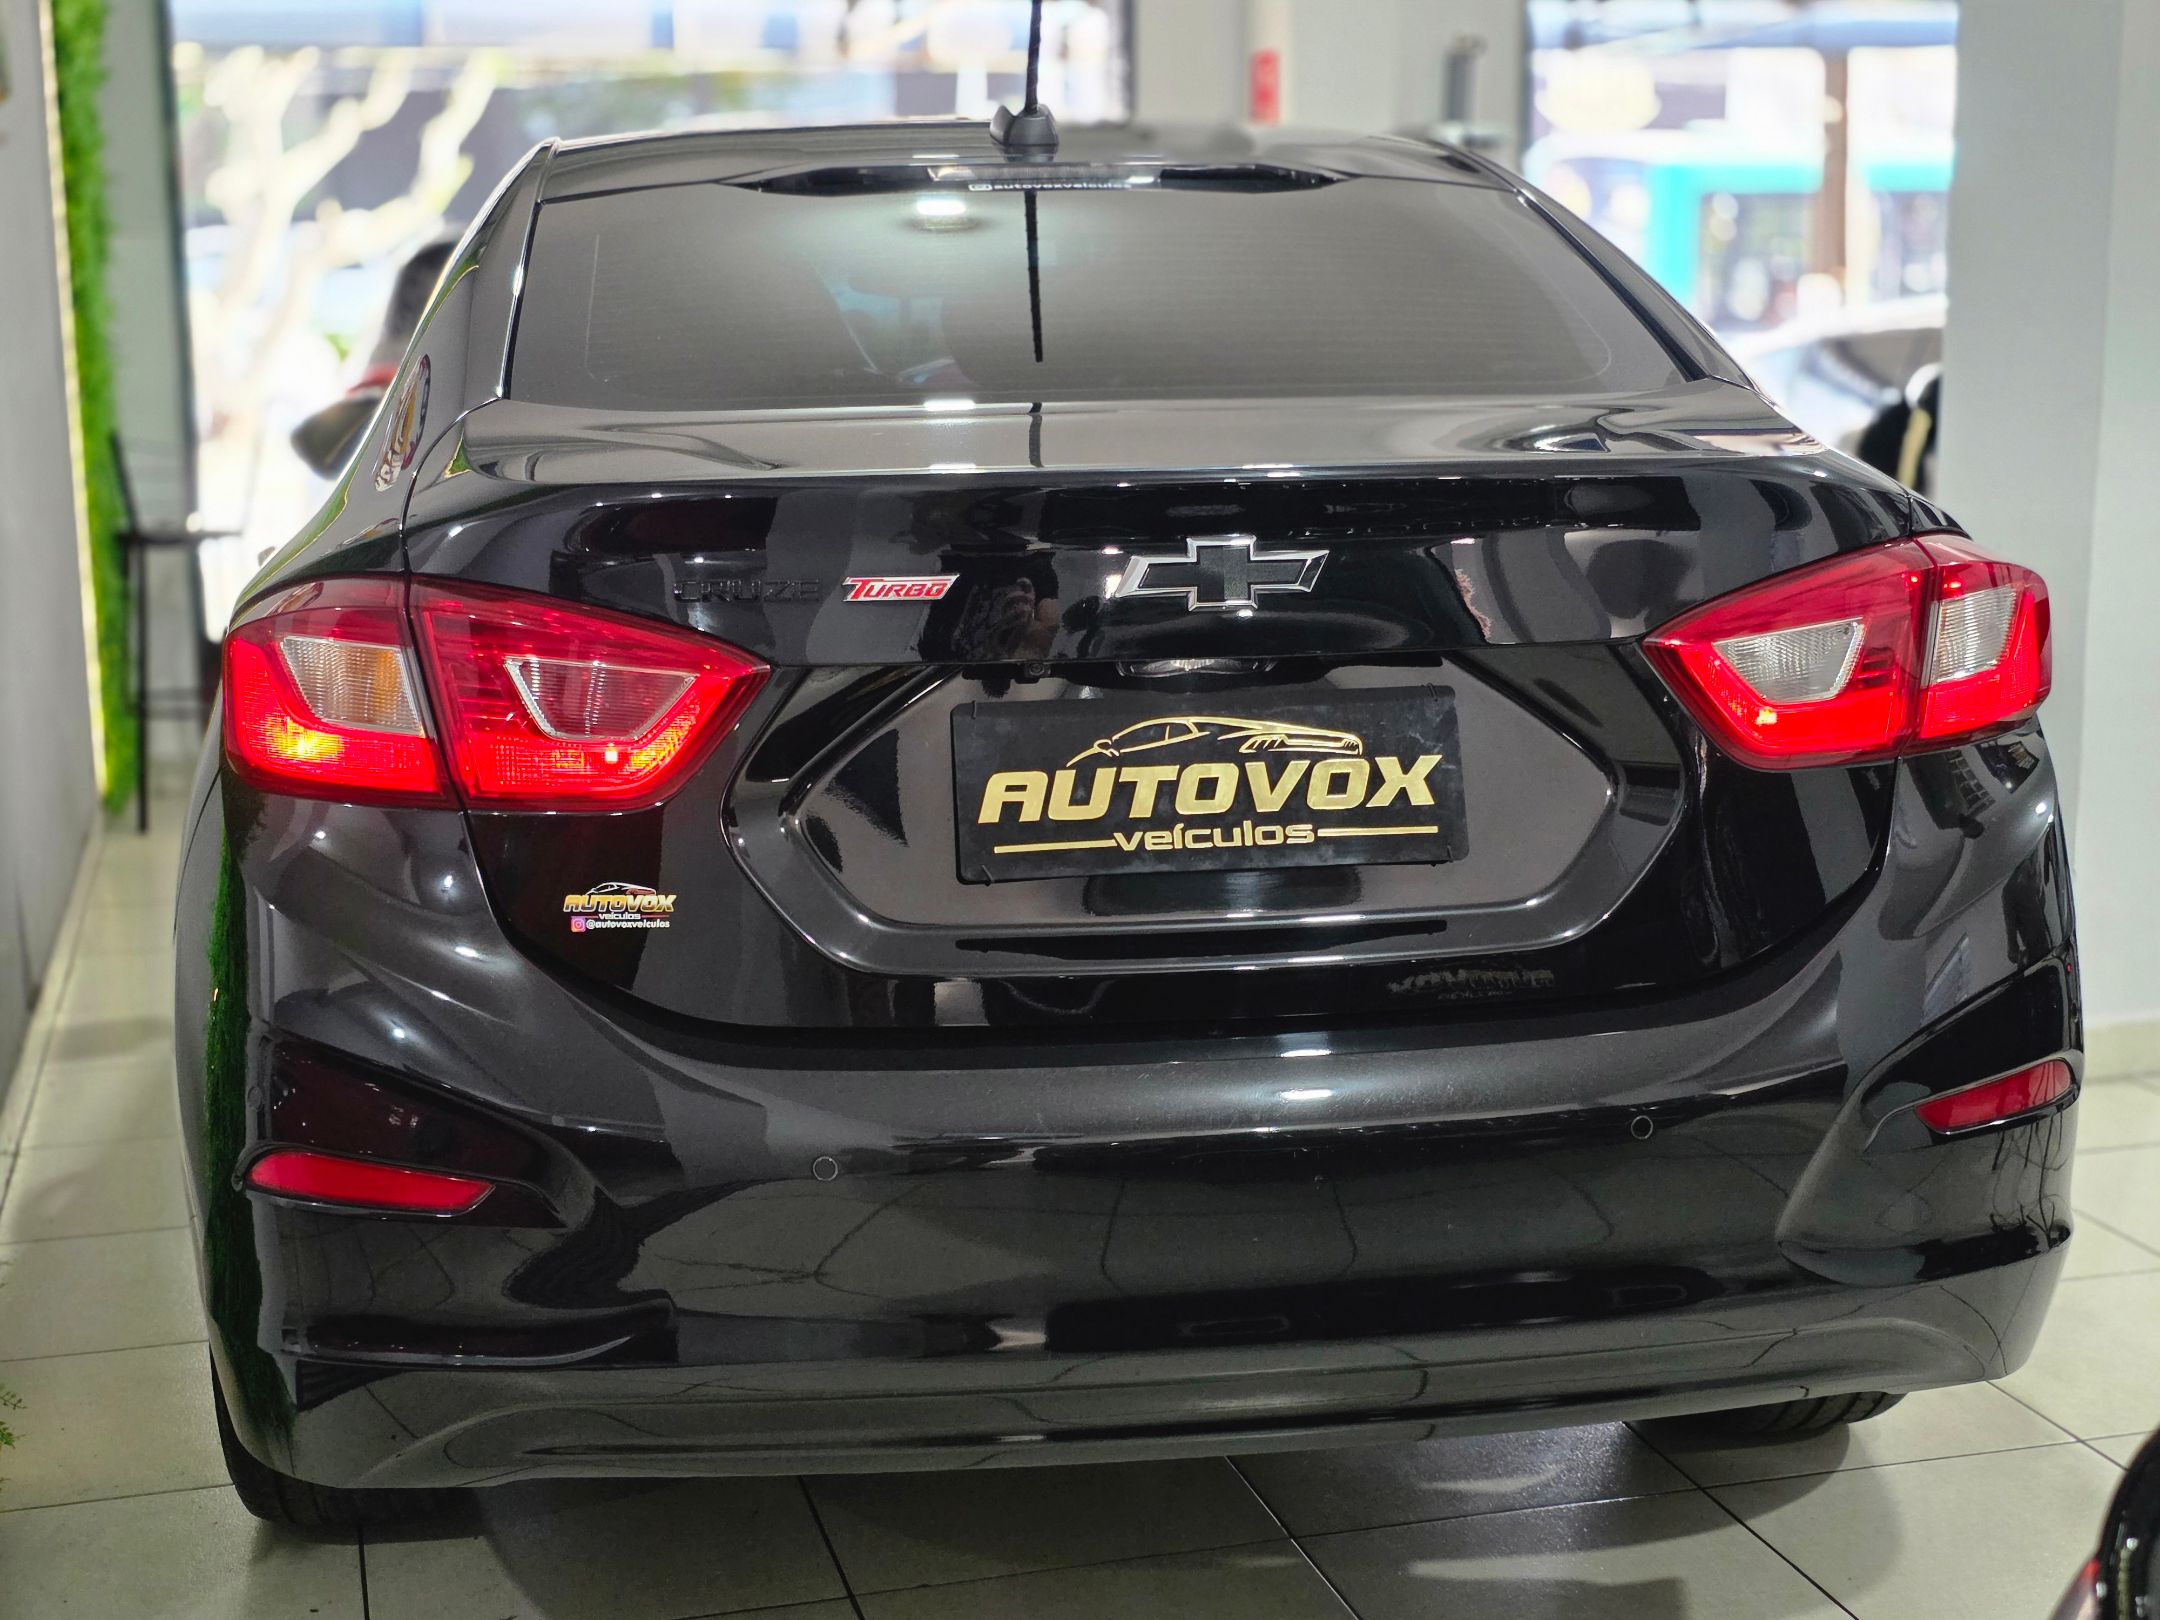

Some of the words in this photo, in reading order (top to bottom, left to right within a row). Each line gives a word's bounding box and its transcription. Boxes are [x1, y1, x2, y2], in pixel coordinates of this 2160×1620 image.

[673, 578, 820, 603] CRUZE
[848, 577, 950, 601] TURBO
[978, 754, 1442, 823] AUTOVOX
[1114, 820, 1317, 851] veículos
[563, 894, 677, 912] AUTOVOX
